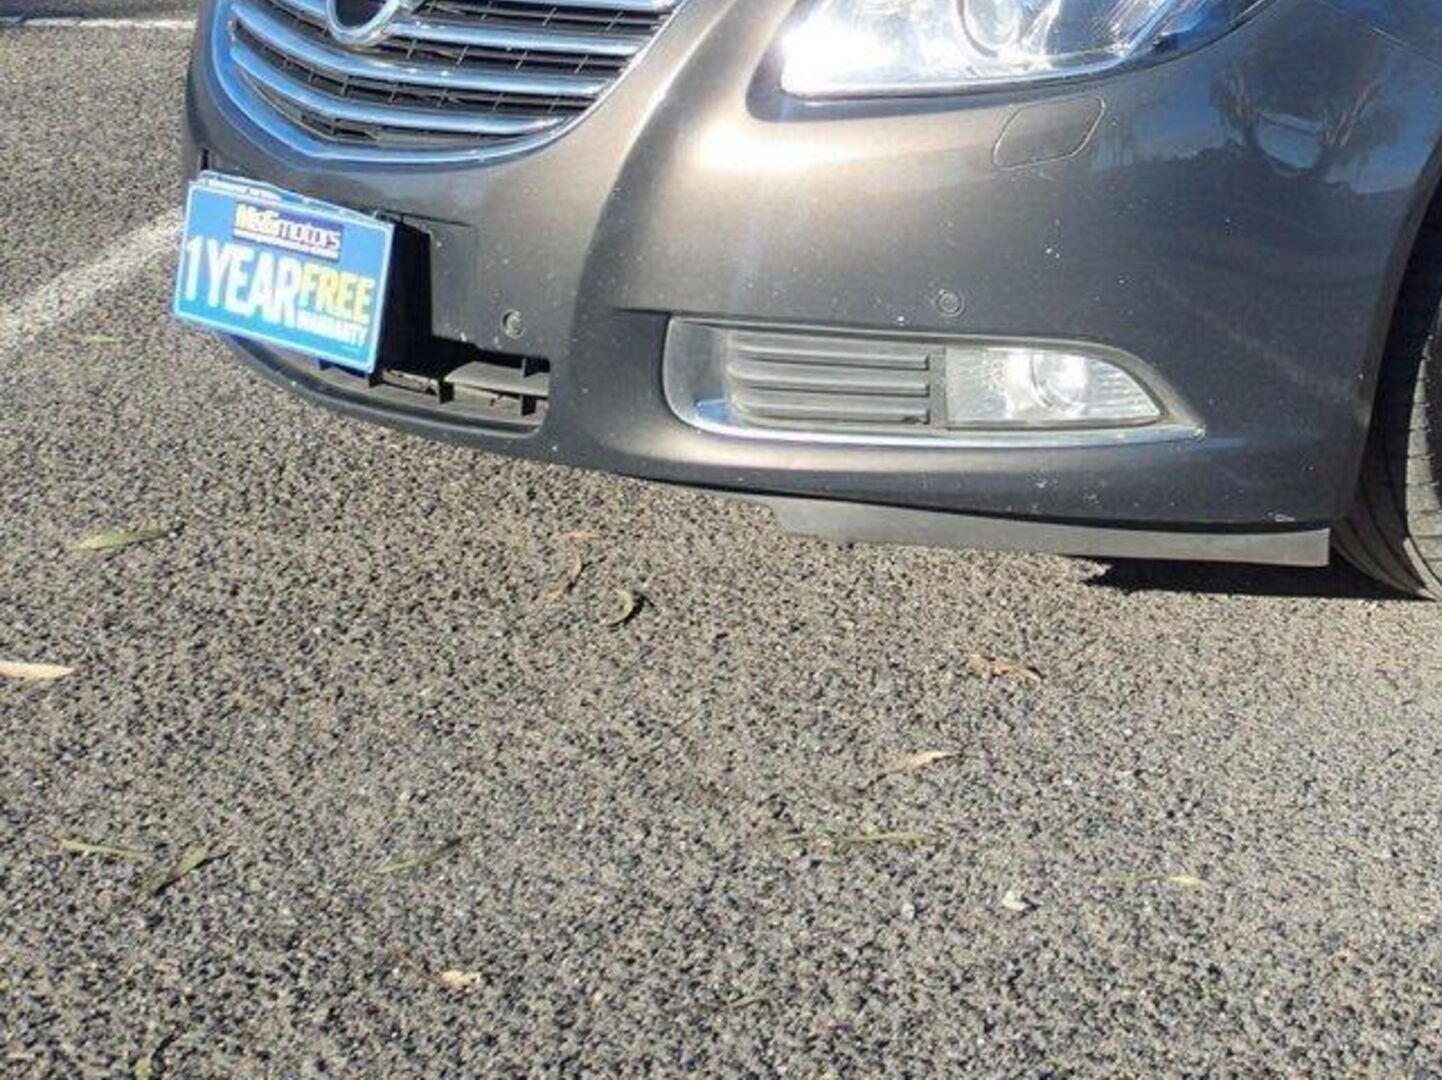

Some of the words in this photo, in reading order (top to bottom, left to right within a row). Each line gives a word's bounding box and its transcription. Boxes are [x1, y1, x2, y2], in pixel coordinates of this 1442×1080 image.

[185, 235, 201, 302] 1
[207, 239, 297, 328] YEAR
[299, 263, 375, 323] FREE
